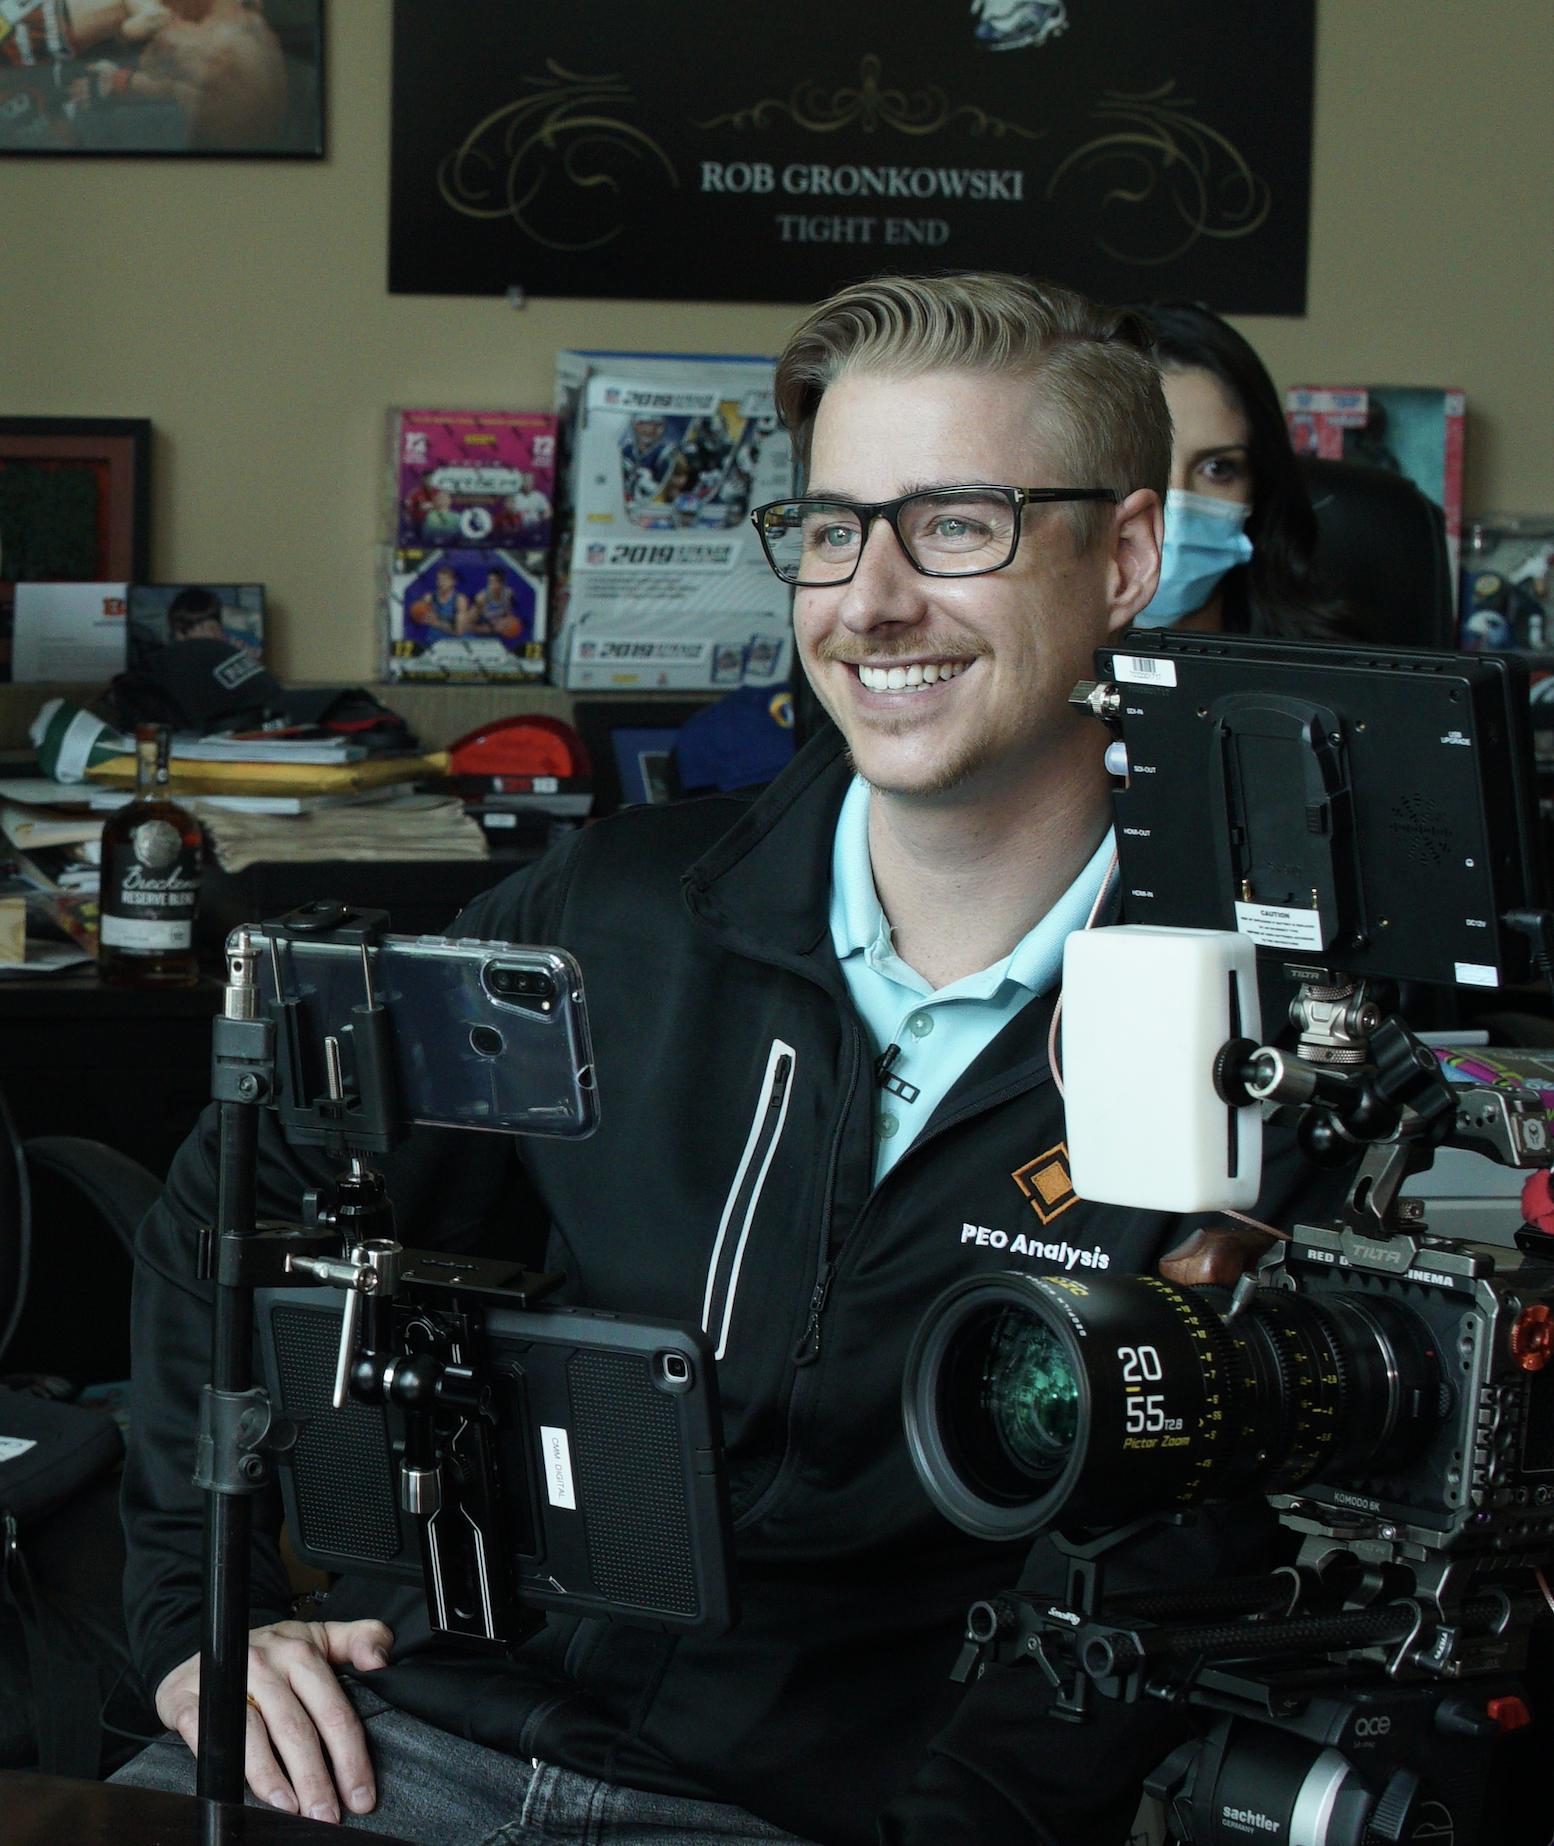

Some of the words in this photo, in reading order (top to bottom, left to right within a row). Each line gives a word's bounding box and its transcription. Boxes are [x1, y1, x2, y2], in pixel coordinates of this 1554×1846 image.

[700, 161, 775, 193] ROB
[782, 164, 1025, 201] GRONKOWSKI
[774, 213, 877, 244] TIGHT
[883, 216, 950, 246] END
[610, 544, 674, 564] 2019
[121, 890, 168, 905] RESERVE
[1260, 909, 1291, 919] CAUTION
[960, 1222, 1009, 1249] PEO
[1009, 1233, 1111, 1271] Analysis
[1307, 1249, 1335, 1263] RED
[1352, 1244, 1401, 1264] TILTA
[1403, 1268, 1454, 1288] INEMA
[1117, 1345, 1163, 1382] 20
[1126, 1394, 1165, 1433] 55
[1123, 1437, 1159, 1450] Pictor
[1161, 1434, 1191, 1448] Zoom
[554, 1464, 566, 1499] DIGITAL
[1333, 1491, 1369, 1509] KOMODO
[1369, 1499, 1380, 1512] 6K
[1354, 1715, 1391, 1737] ace
[1222, 1805, 1280, 1833] sachtler
[1222, 1818, 1255, 1834] GERMANY
